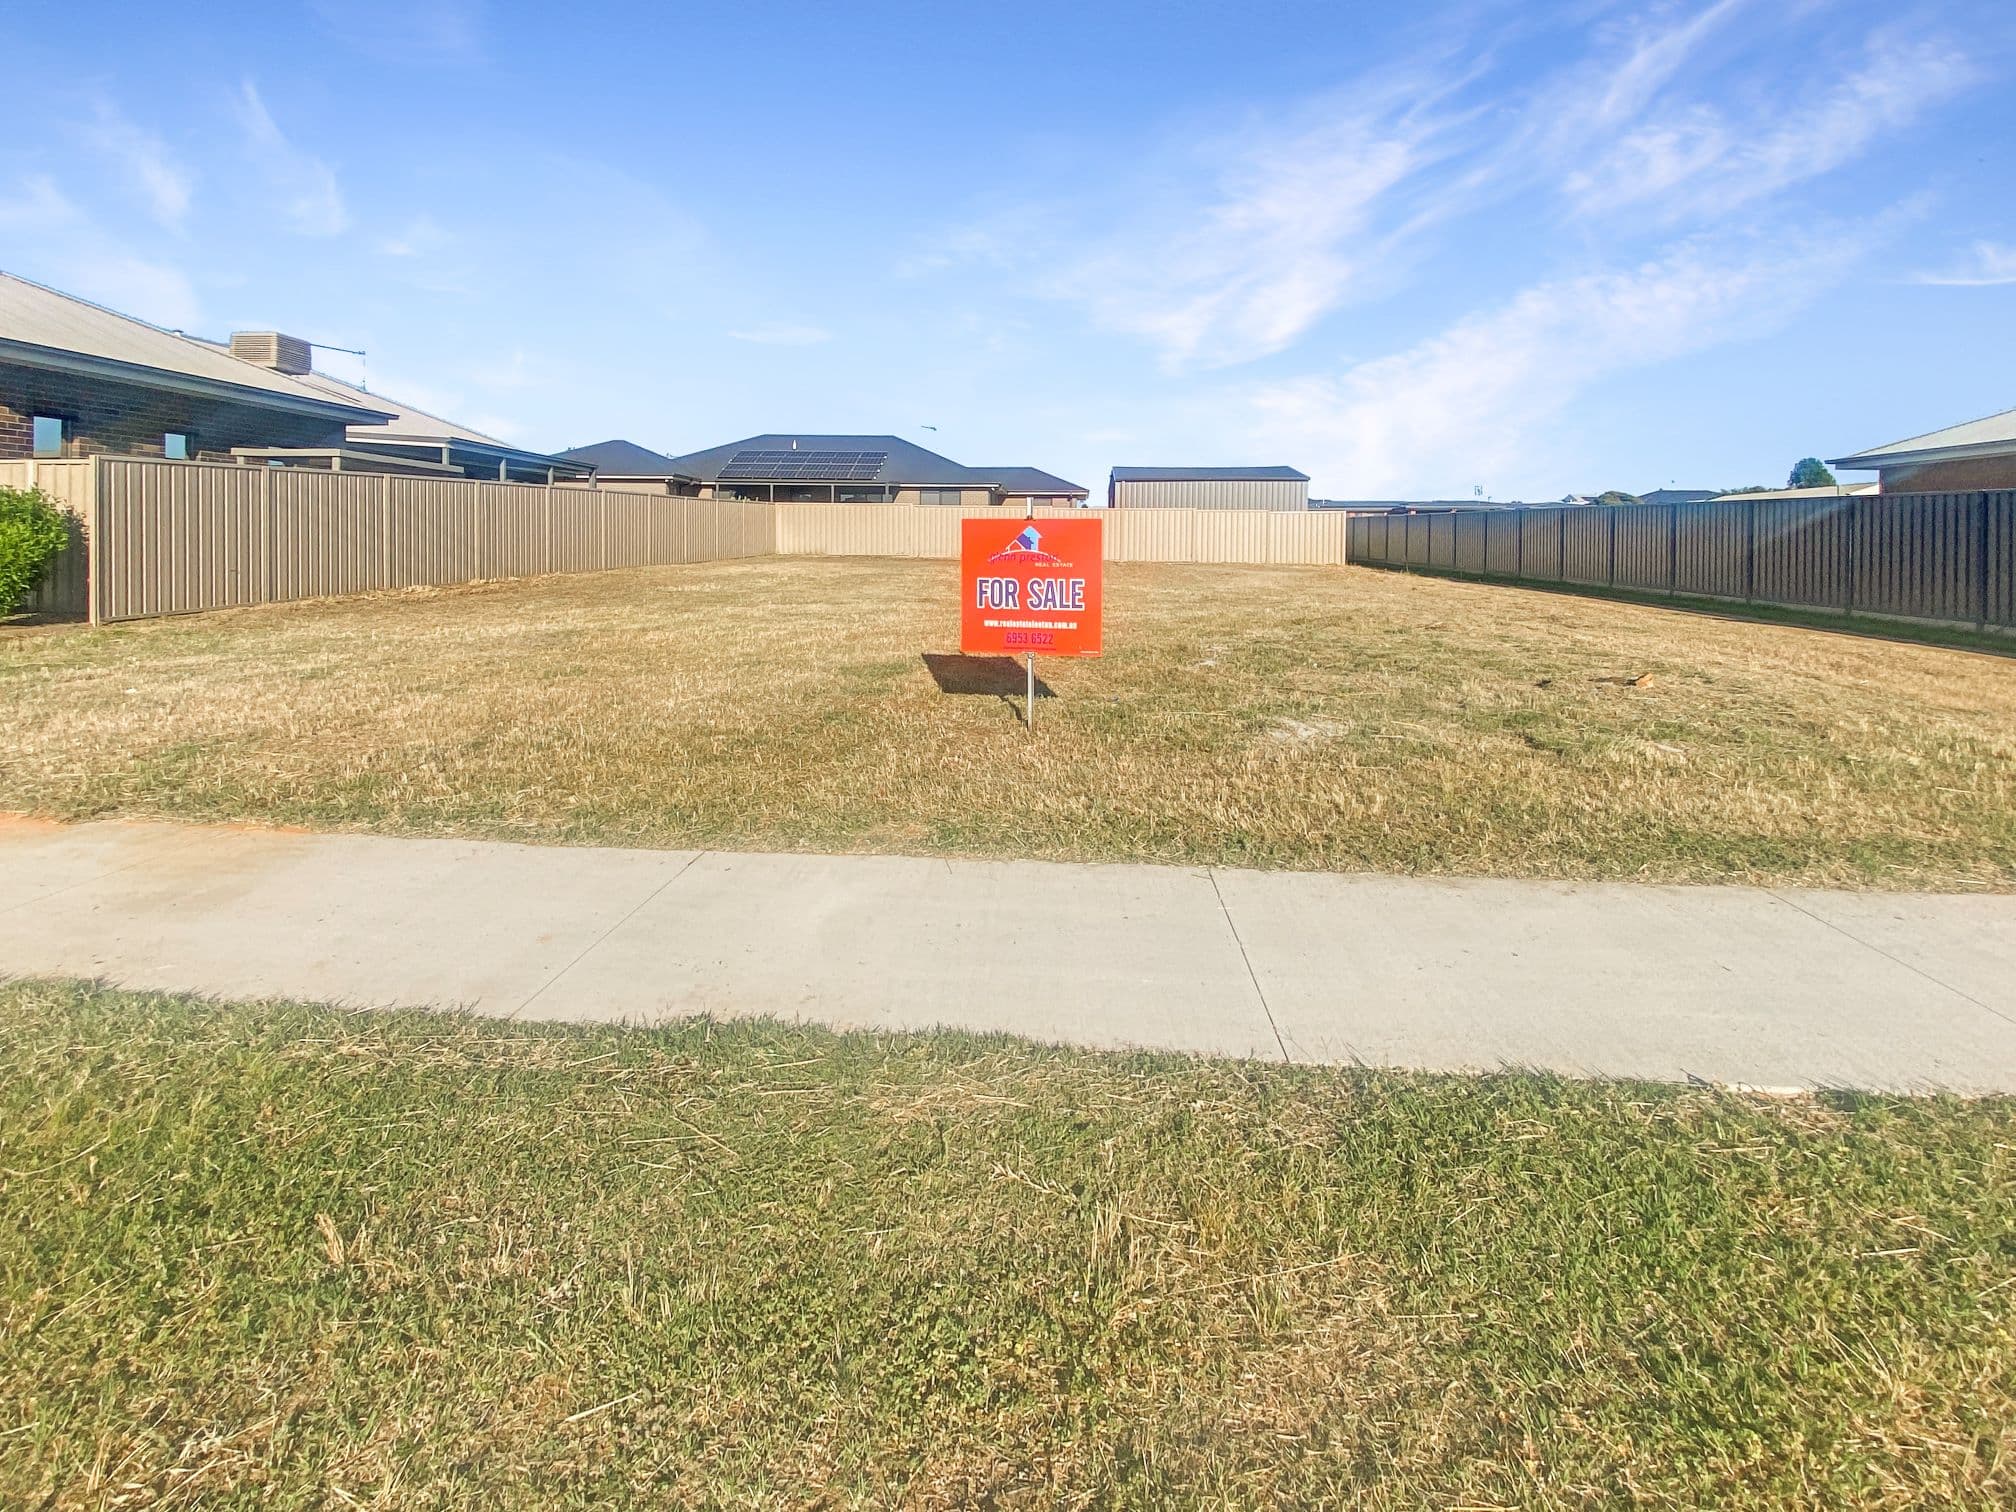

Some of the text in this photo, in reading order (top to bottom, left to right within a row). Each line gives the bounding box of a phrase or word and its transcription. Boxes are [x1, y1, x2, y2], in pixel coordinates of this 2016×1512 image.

[977, 577, 1085, 610] FOR SALE
[1006, 632, 1054, 645] 6953 6522
